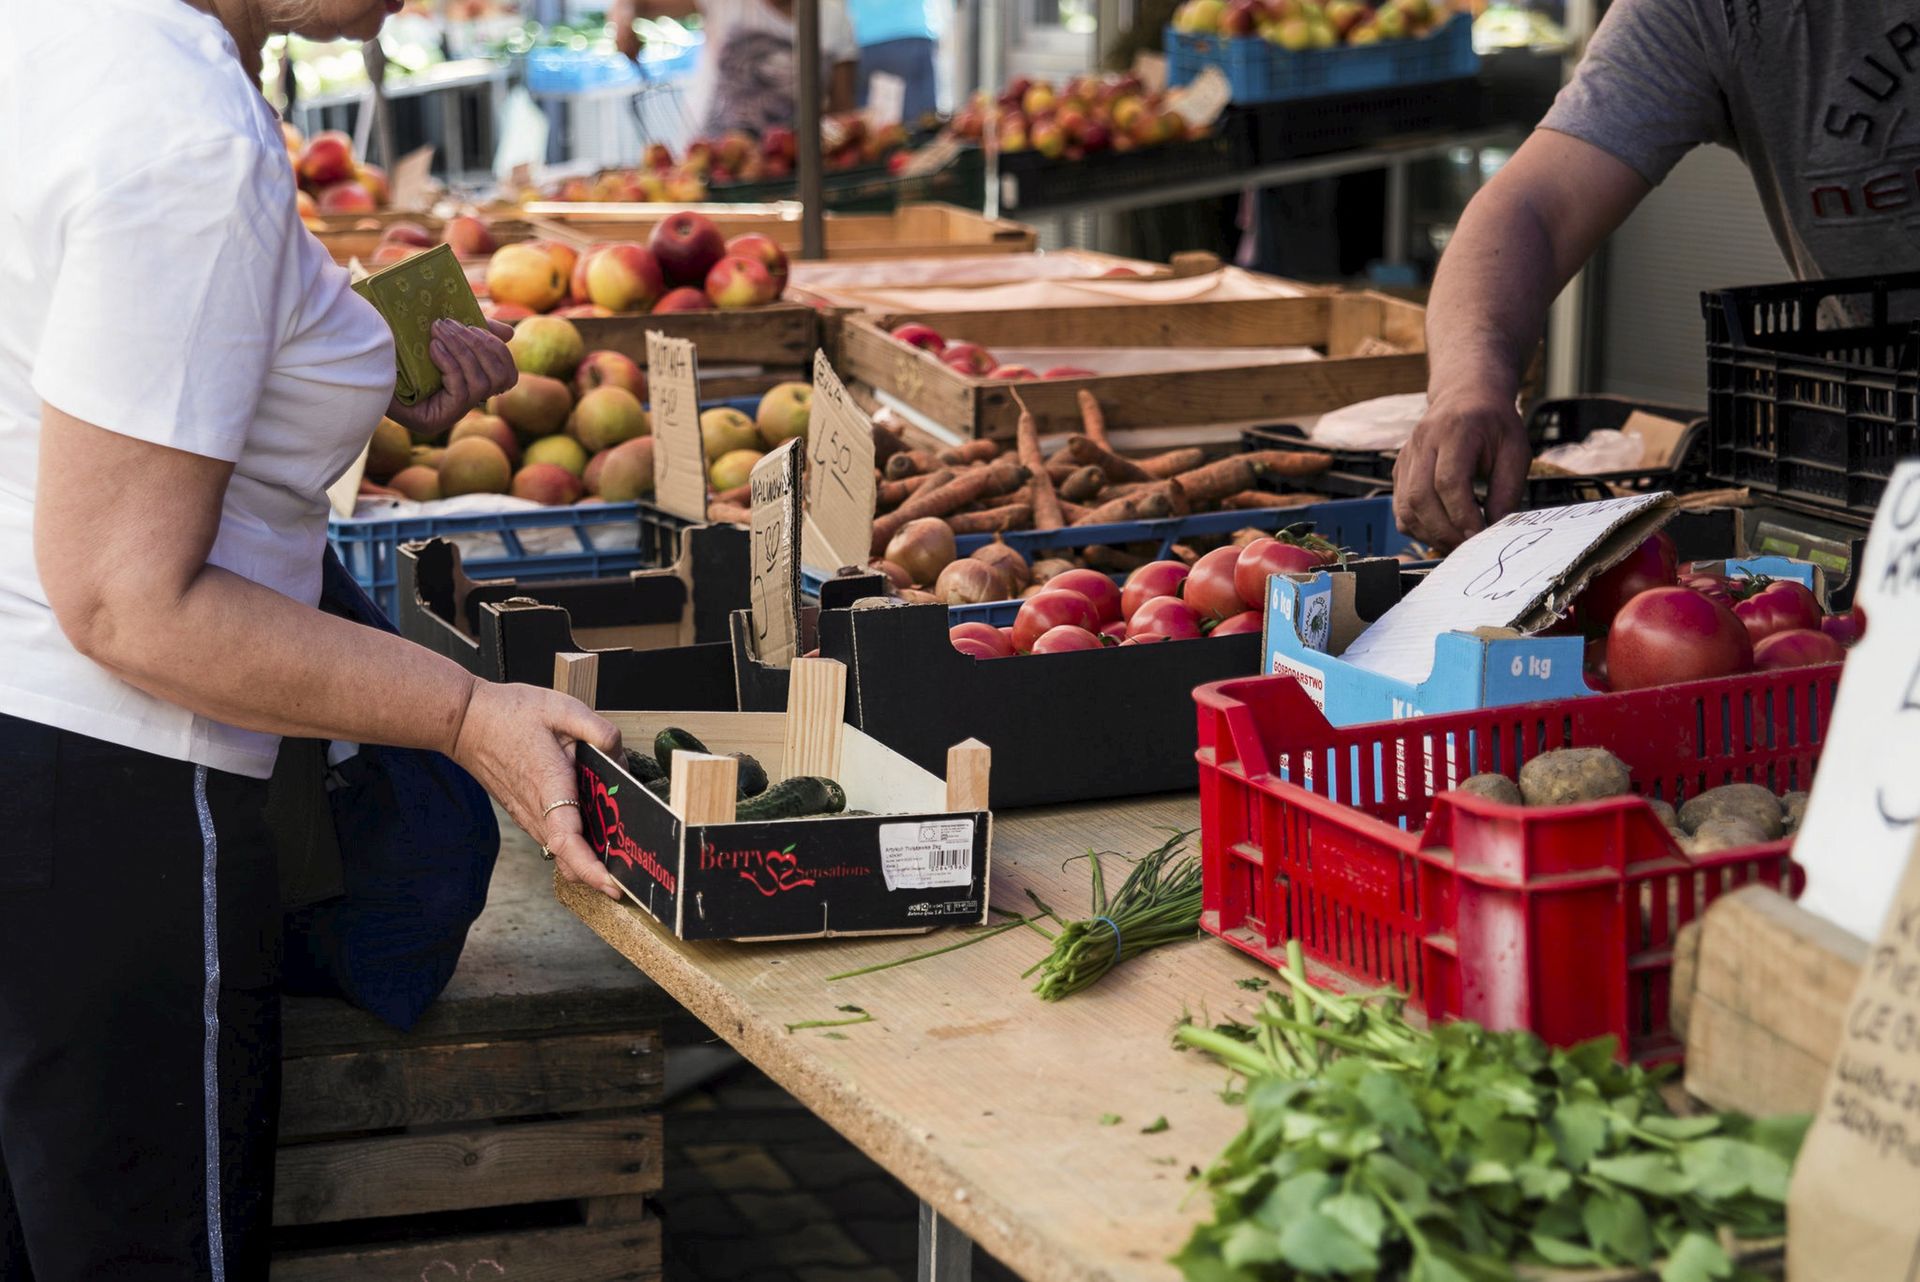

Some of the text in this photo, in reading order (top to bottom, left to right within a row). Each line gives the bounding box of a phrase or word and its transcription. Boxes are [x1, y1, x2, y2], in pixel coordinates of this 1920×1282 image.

[1272, 588, 1292, 621] 6 kg
[1511, 655, 1552, 680] 6 kg
[617, 822, 676, 895] Sensations
